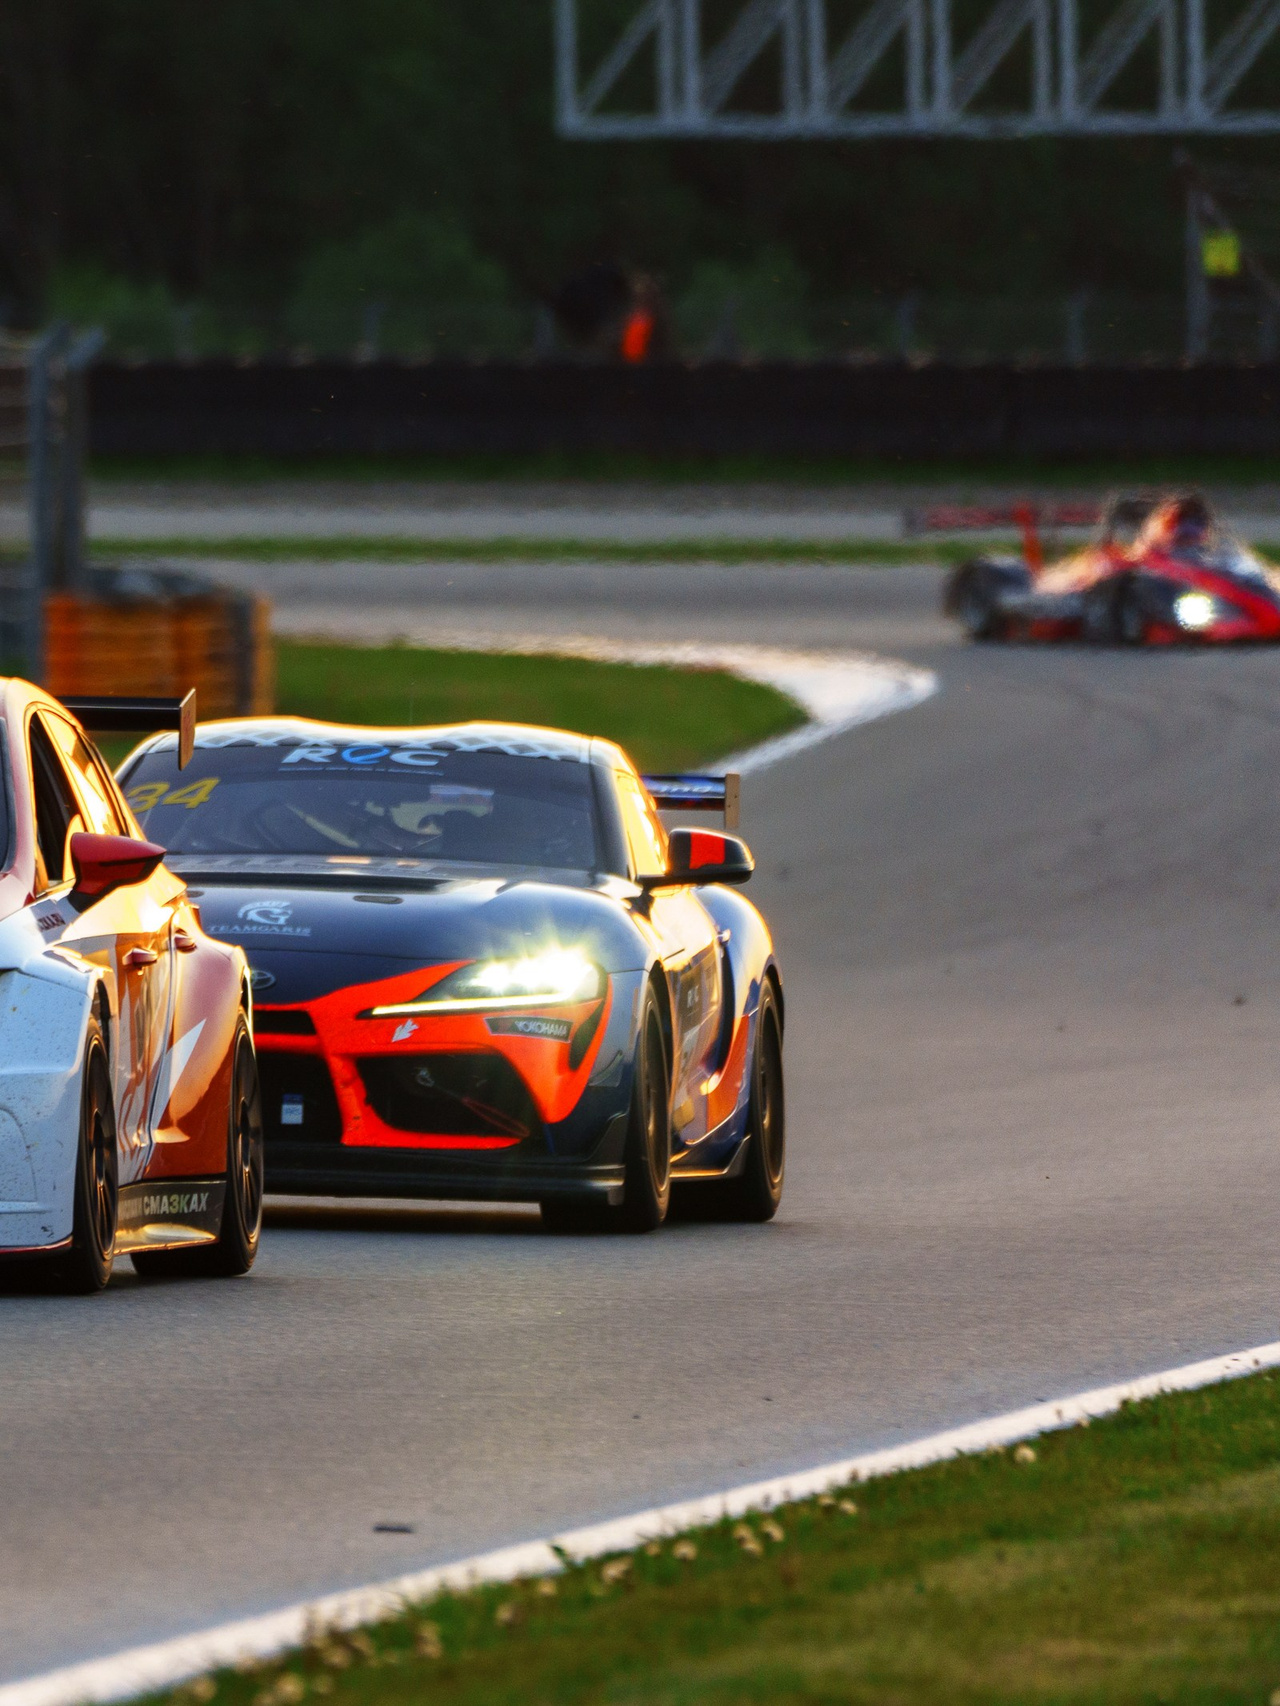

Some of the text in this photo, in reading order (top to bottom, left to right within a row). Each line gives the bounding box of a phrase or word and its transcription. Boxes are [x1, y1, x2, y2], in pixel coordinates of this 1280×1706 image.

[127, 777, 219, 814] 34
[514, 1020, 568, 1036] YOKOHAMA
[143, 1192, 209, 1215] СМАЗКАХ
